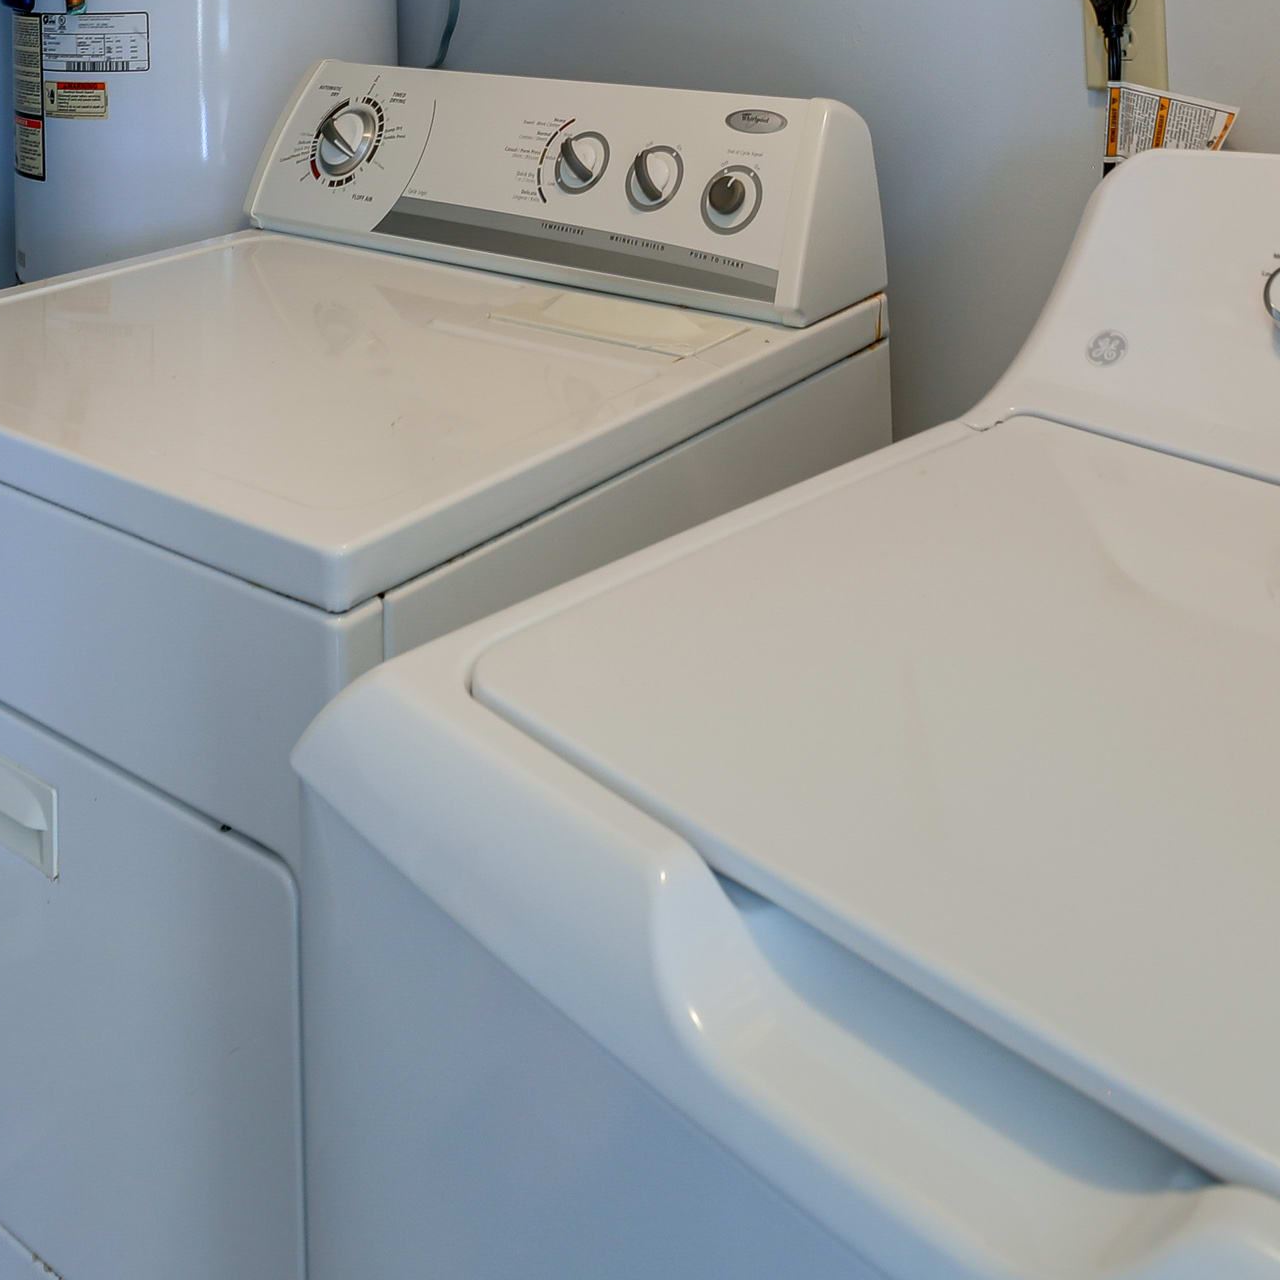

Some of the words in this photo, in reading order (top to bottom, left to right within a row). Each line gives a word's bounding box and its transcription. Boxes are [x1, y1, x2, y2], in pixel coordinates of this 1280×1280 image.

[741, 112, 769, 124] Whirlpool
[541, 222, 584, 236] TEMPERATURE
[610, 235, 638, 247] WRINKLE
[641, 241, 665, 252] SHIELD
[689, 251, 708, 261] PUSH
[711, 256, 719, 264] TO
[722, 258, 744, 270] START
